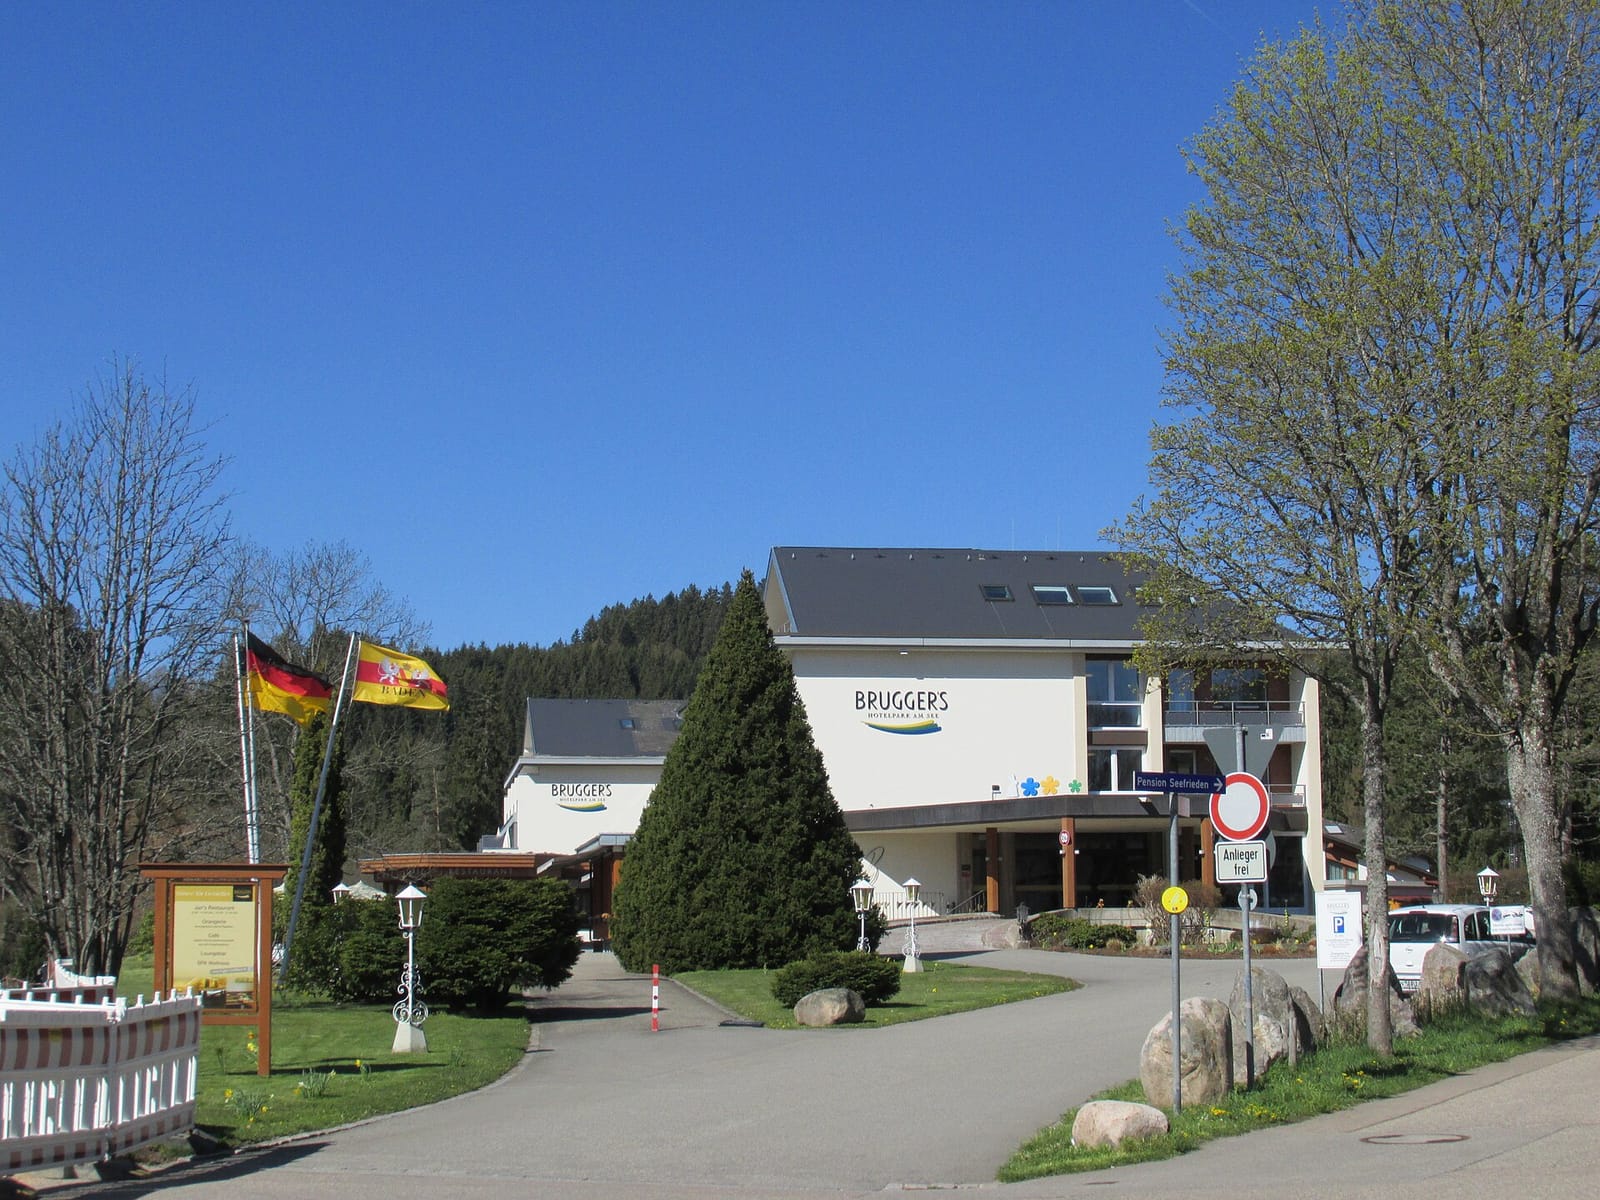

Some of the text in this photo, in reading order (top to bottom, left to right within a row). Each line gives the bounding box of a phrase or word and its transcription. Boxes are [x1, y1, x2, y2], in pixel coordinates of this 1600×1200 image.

[381, 685, 426, 698] BADEN
[1137, 776, 1209, 789] Pension Seefrieden
[1223, 848, 1258, 863] Anlieger
[1234, 864, 1249, 876] frei
